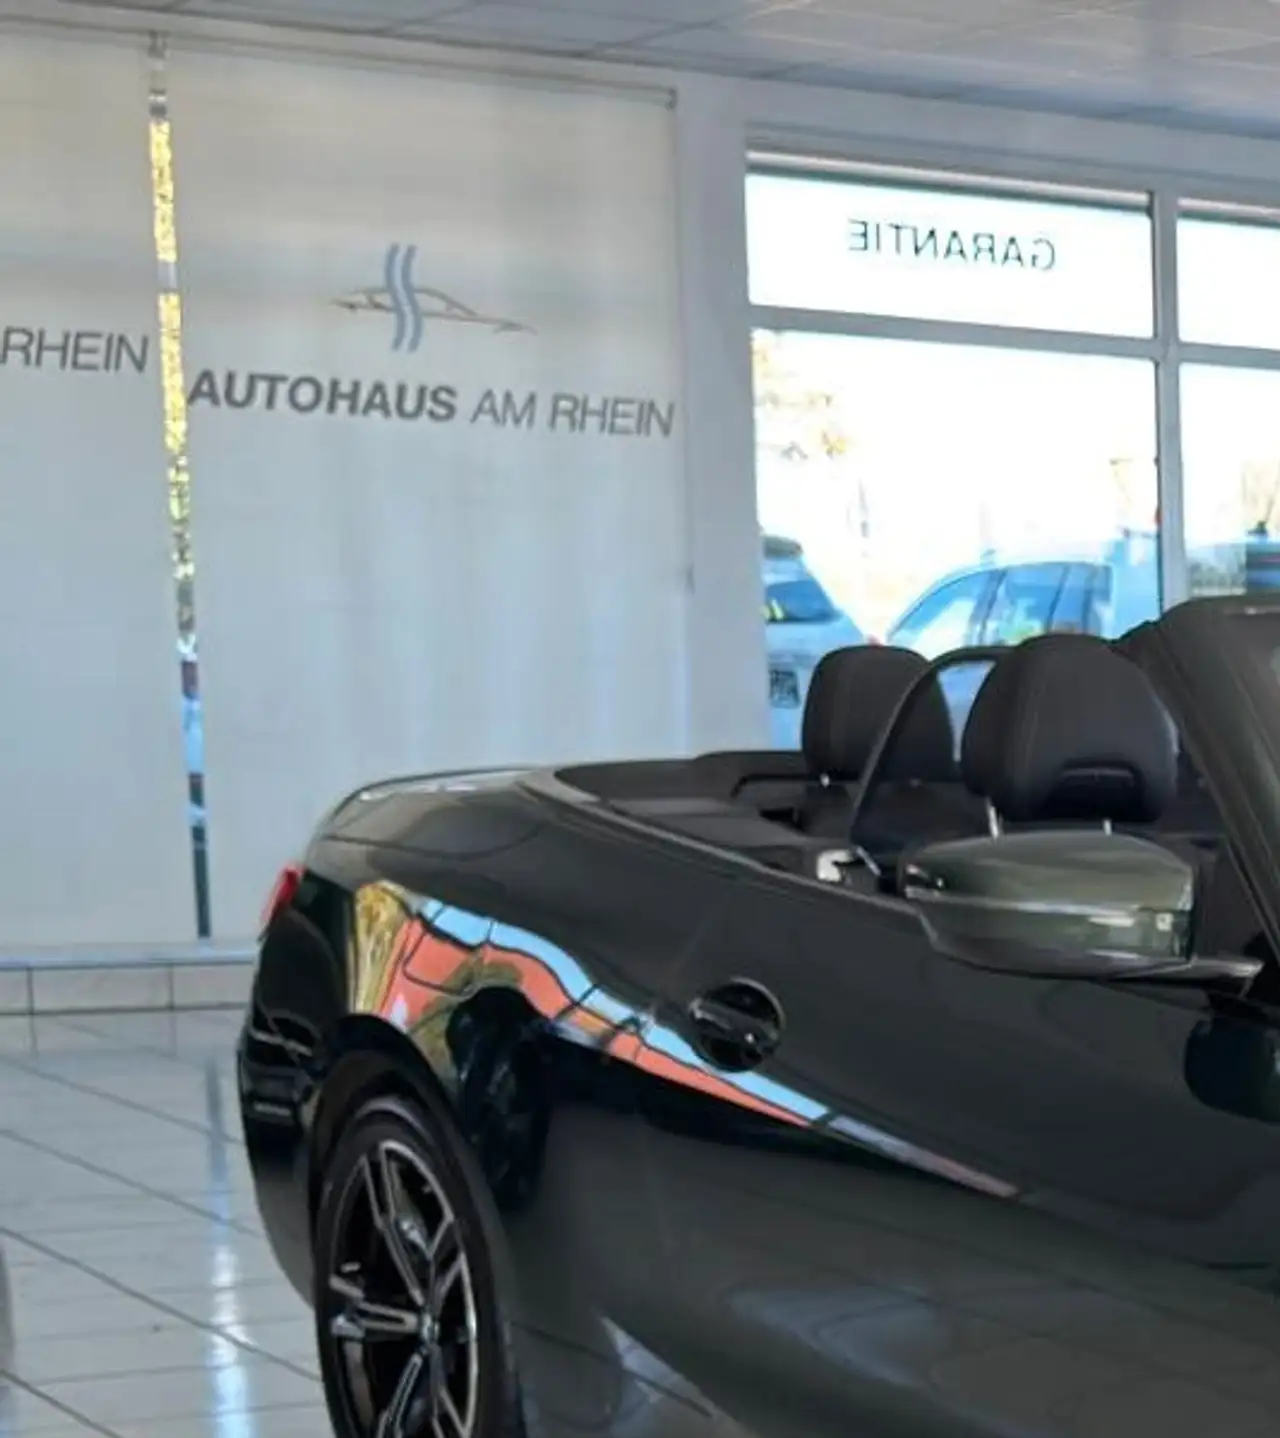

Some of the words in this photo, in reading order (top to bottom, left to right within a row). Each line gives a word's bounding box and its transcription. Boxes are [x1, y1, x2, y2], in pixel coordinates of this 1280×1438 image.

[0, 325, 149, 373] RHEIN
[187, 368, 457, 423] AUTOHAUS
[471, 388, 536, 432] AM
[548, 393, 677, 439] RHEIN
